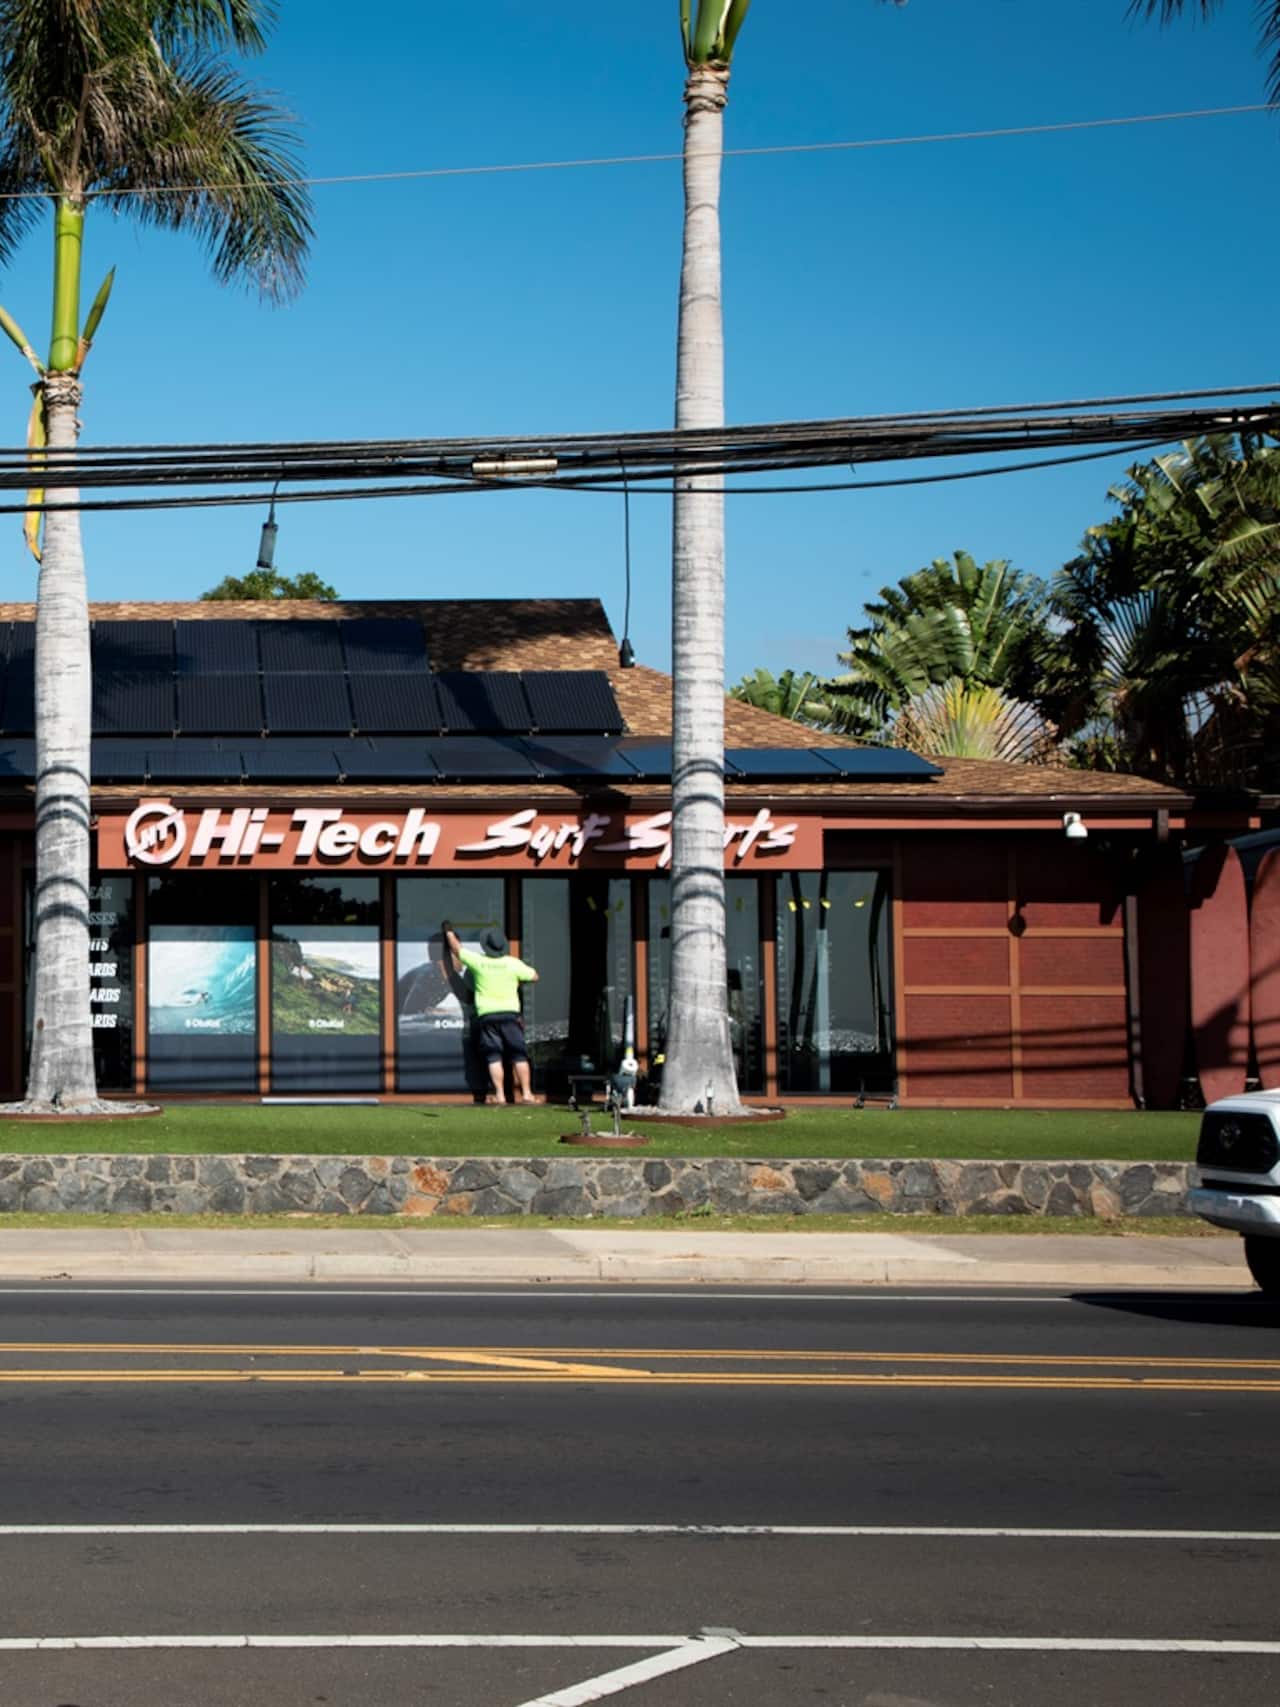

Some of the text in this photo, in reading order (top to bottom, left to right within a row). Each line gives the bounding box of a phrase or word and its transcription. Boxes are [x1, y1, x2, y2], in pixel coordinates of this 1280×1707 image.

[190, 808, 798, 868] Hi-Tech Surf Srts
[88, 886, 113, 900] EAR
[88, 912, 117, 925] SSES
[88, 963, 118, 977] ARDS
[88, 988, 121, 1002] ARDS
[88, 1014, 118, 1028] ARDS
